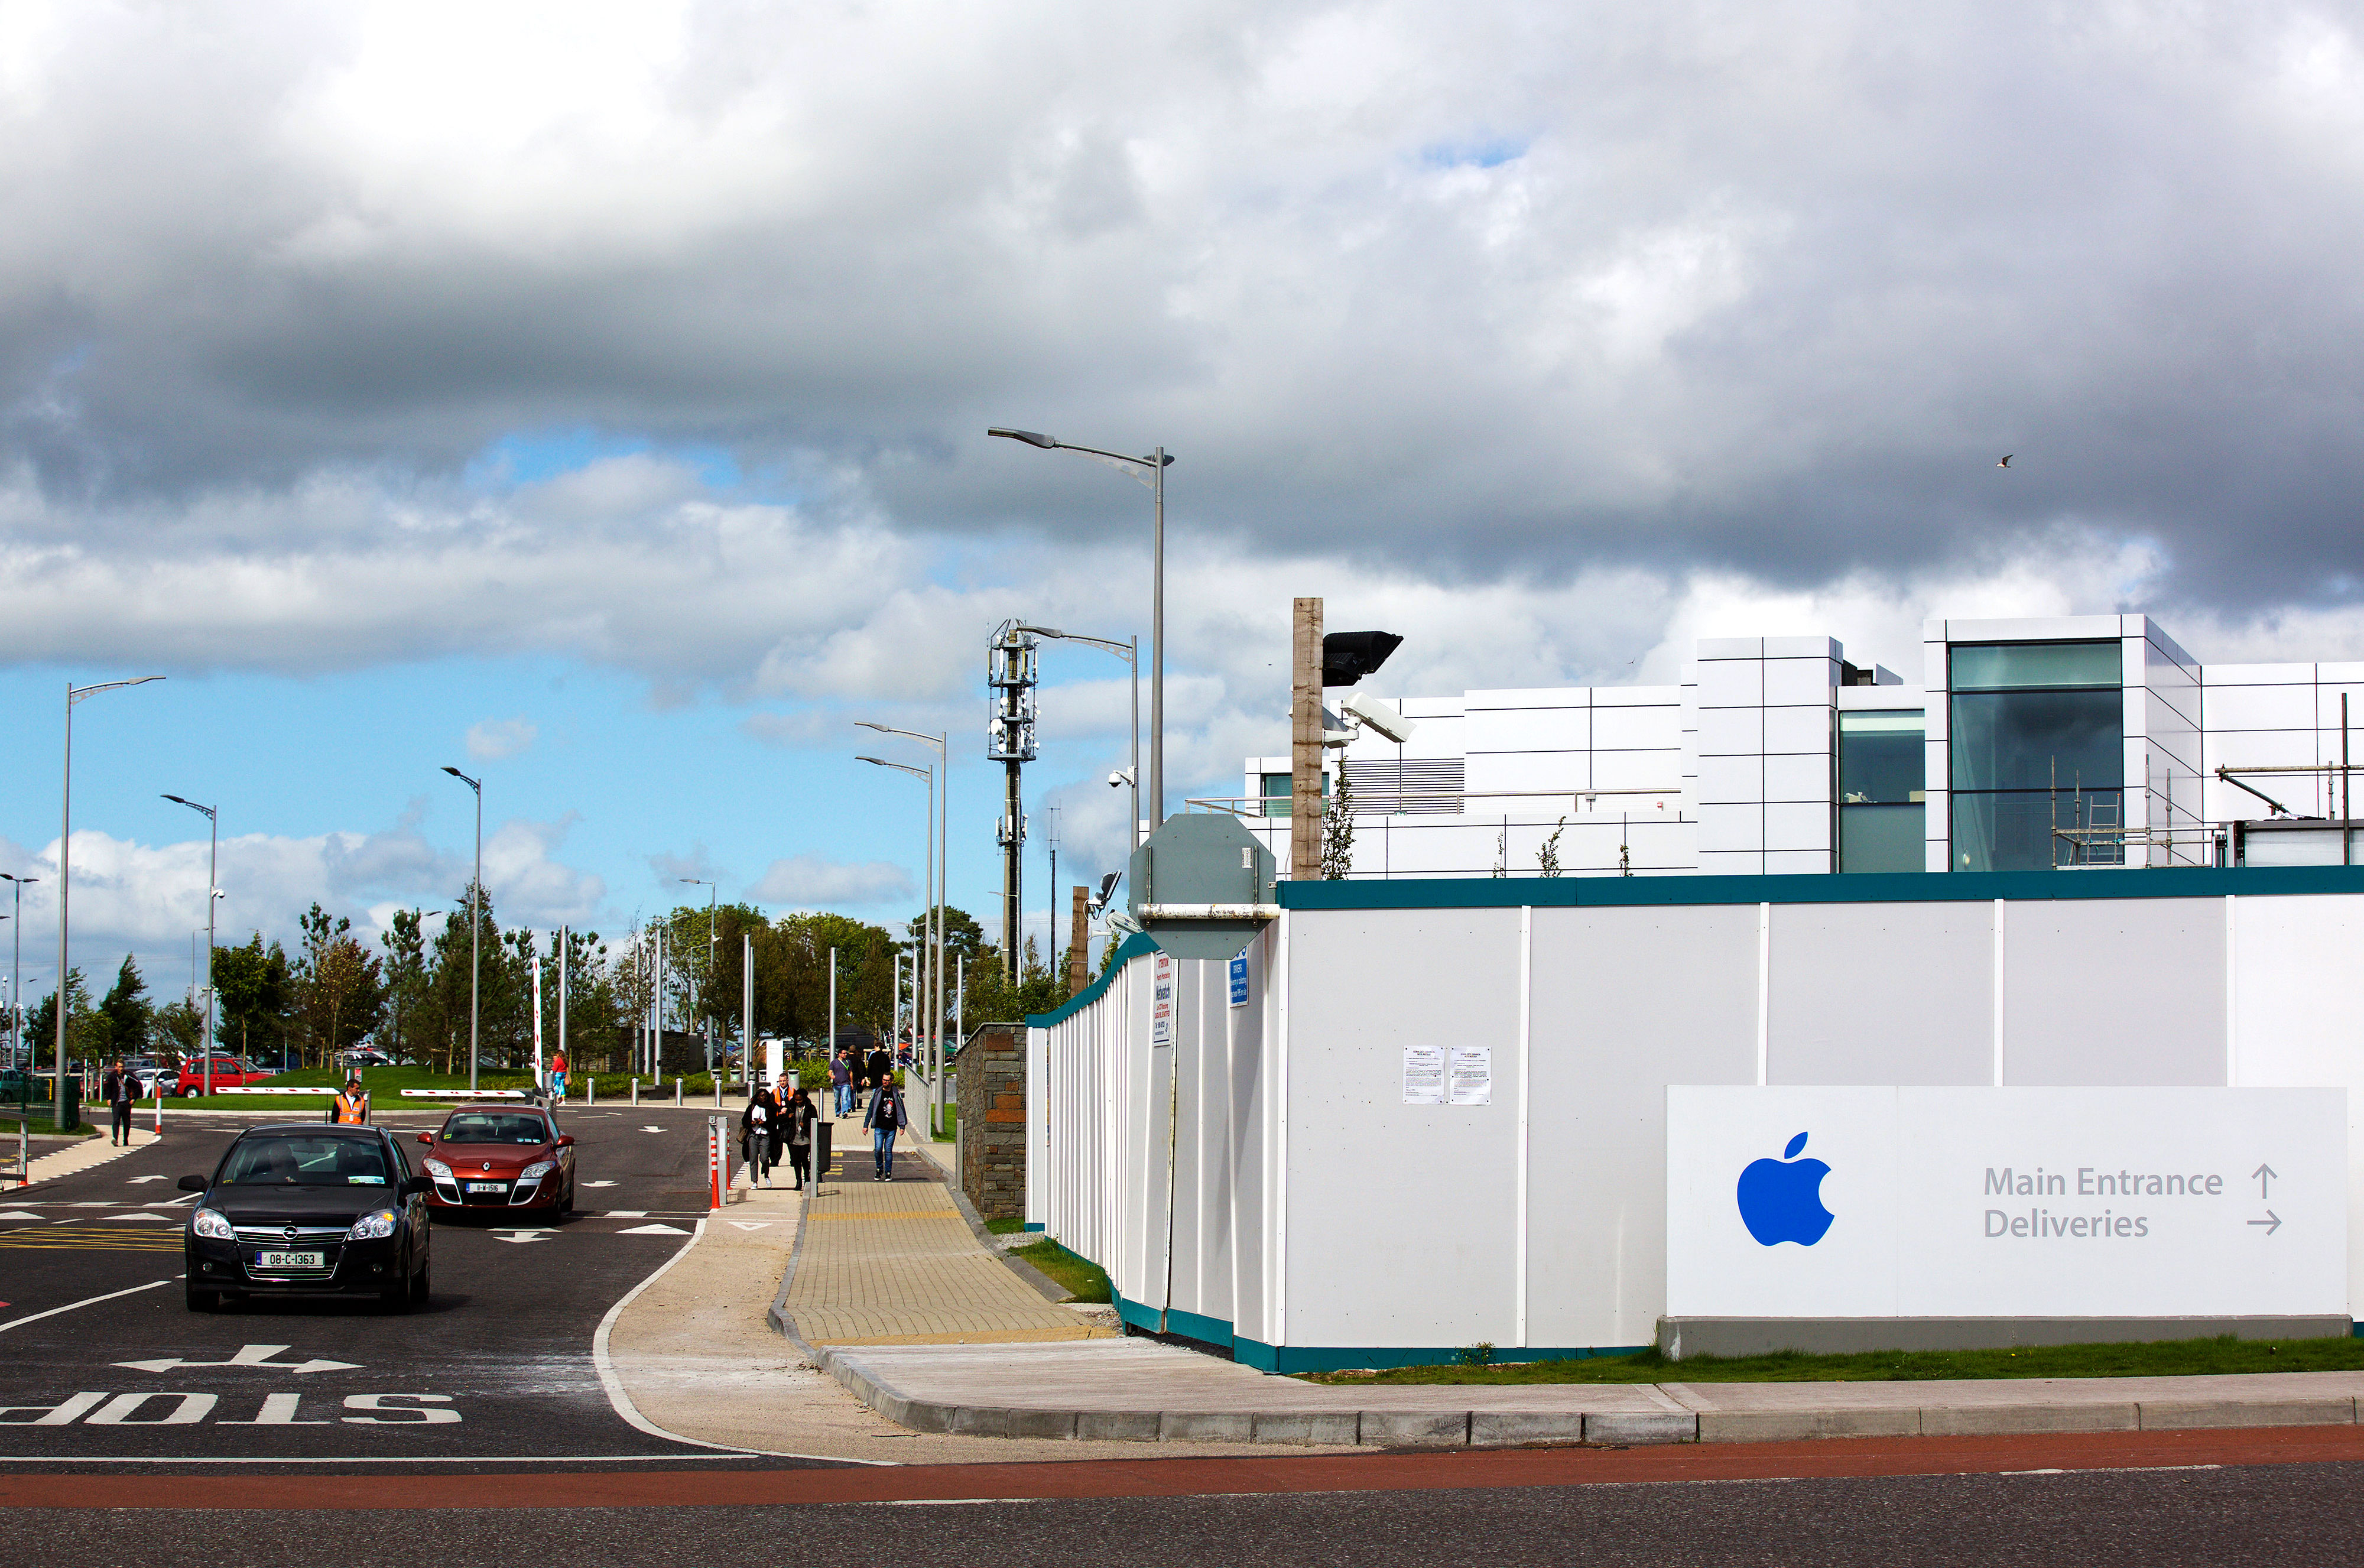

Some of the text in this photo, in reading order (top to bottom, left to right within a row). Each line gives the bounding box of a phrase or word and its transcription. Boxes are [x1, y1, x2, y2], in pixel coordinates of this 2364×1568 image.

[1984, 1167, 2222, 1196] Main Entrance
[1985, 1208, 2148, 1238] Deliveries
[270, 1254, 315, 1264] 08-C-1363
[0, 1391, 462, 1425] STOP
